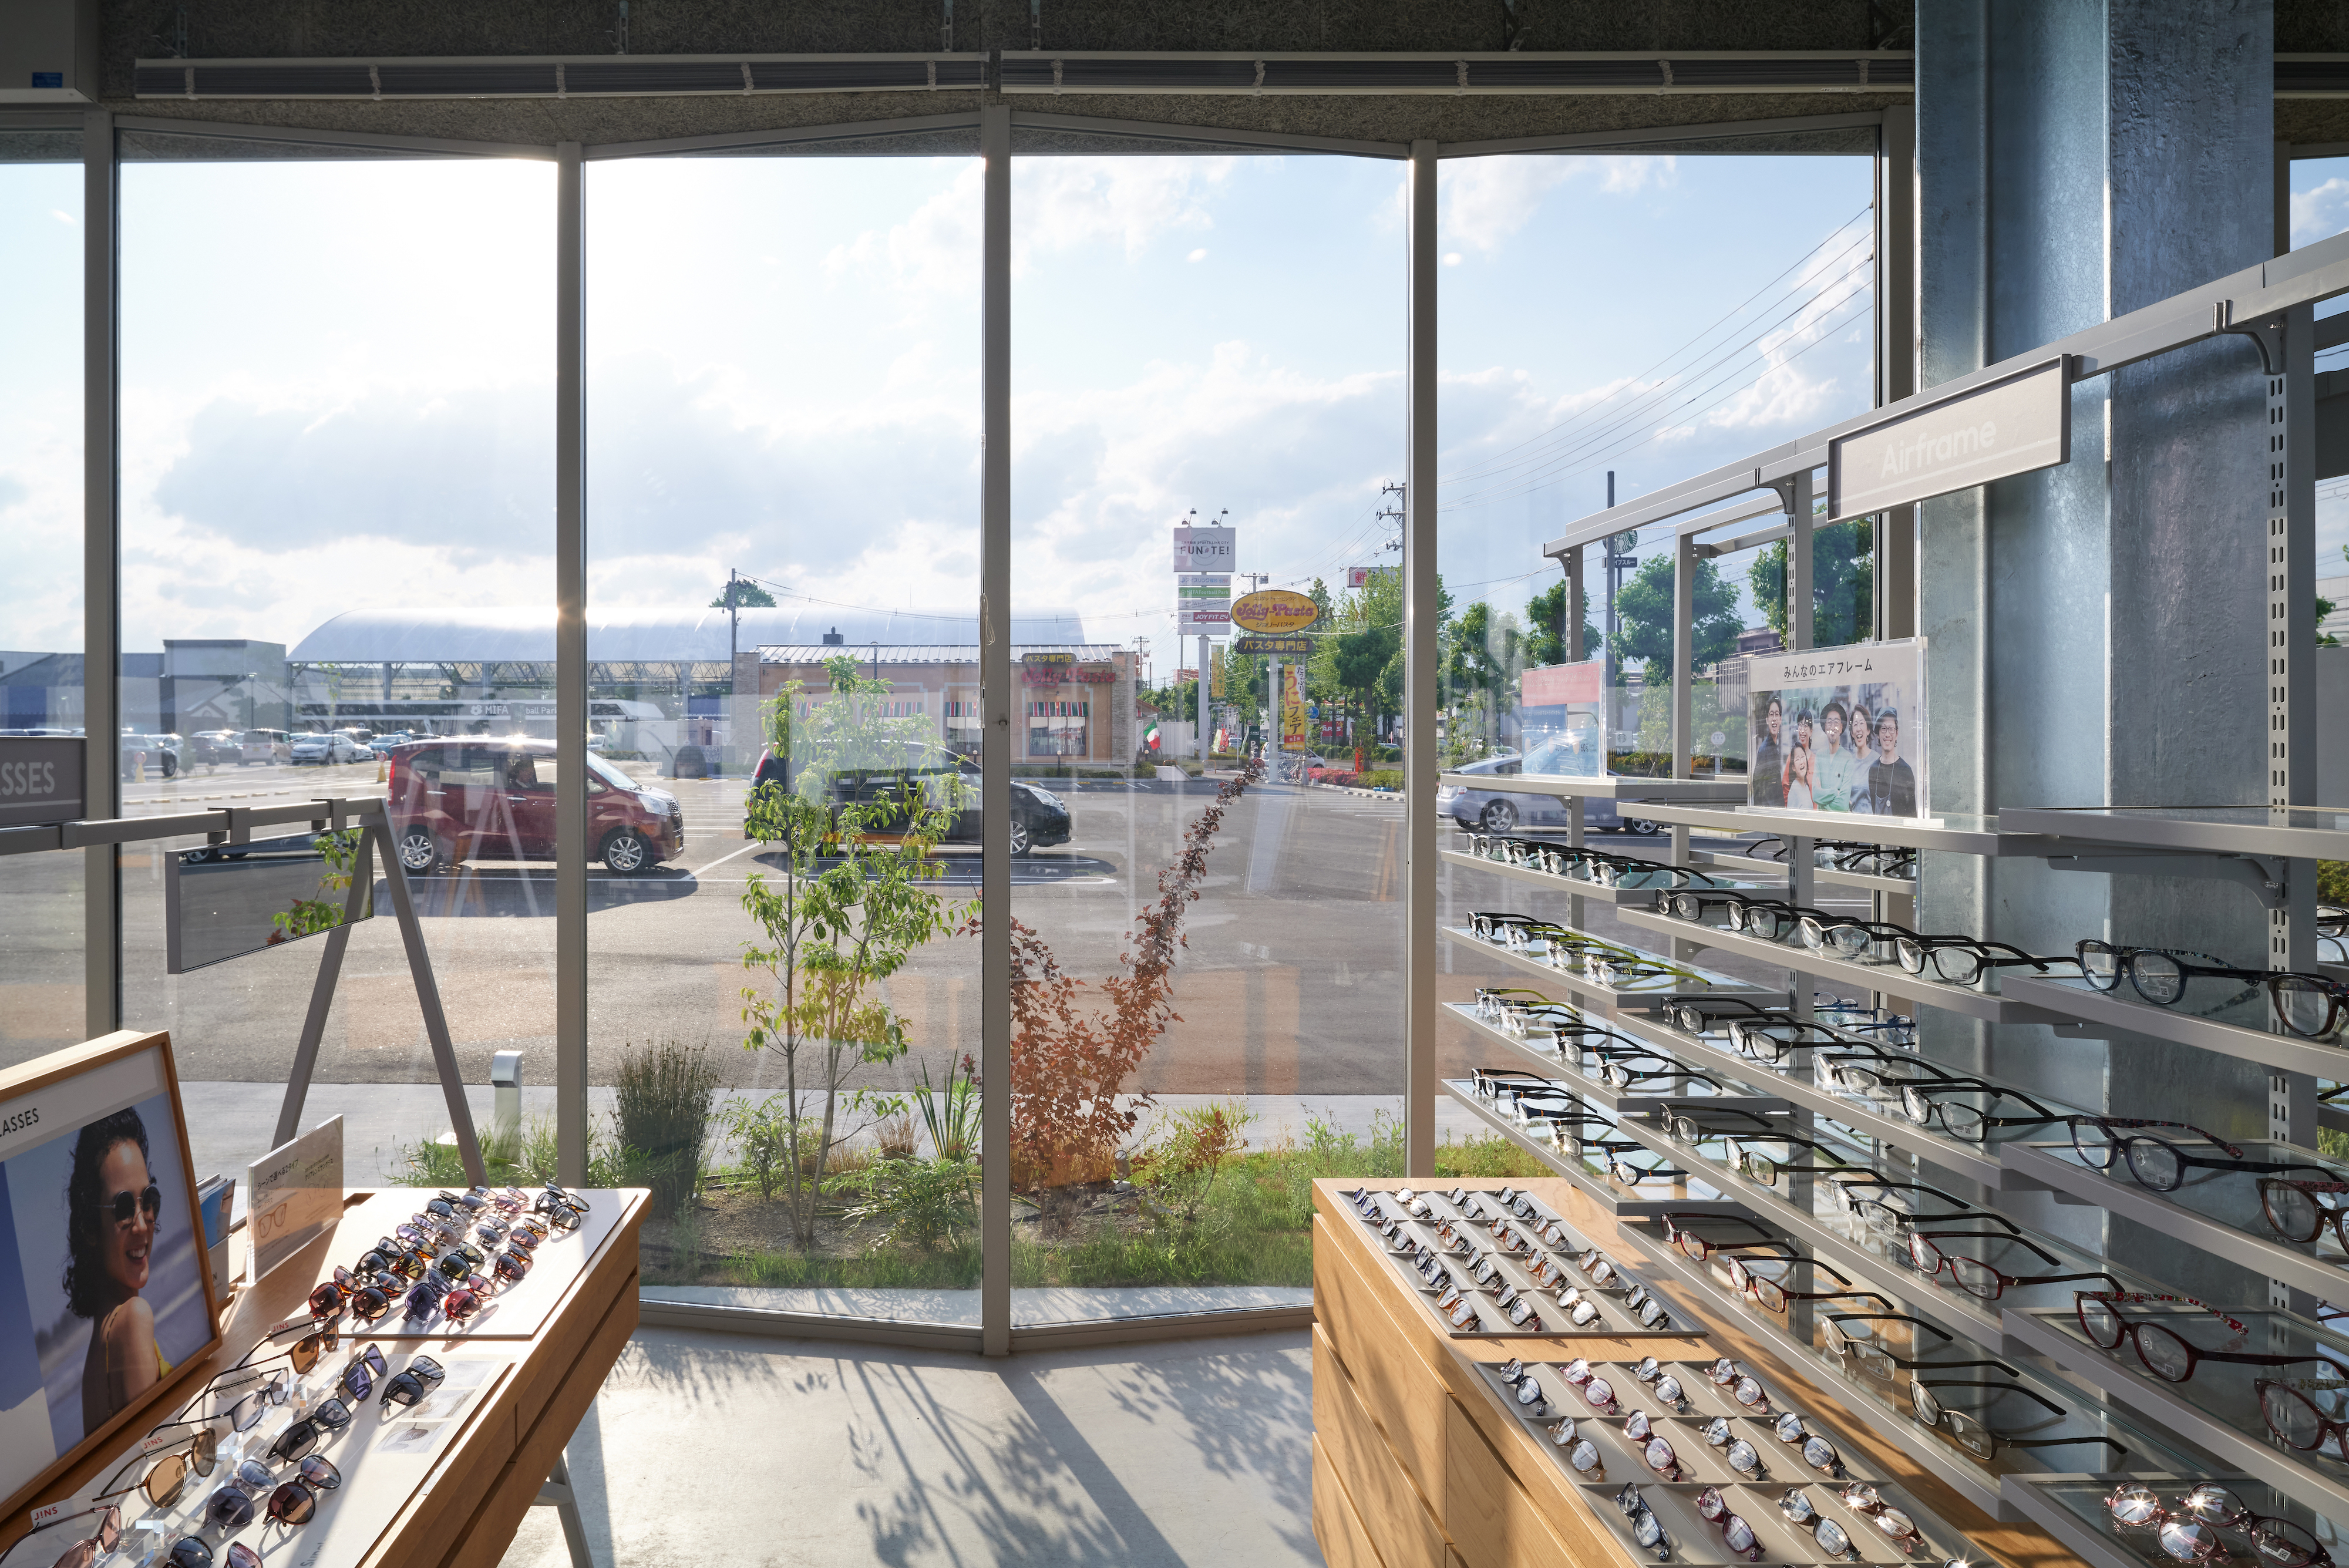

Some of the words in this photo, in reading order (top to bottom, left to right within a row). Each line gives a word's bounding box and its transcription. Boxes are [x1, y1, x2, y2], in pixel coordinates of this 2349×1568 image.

[1880, 420, 1997, 479] Airframe
[1180, 546, 1203, 554] FUN
[1236, 603, 1314, 621] Jolly-Pasta
[1244, 640, 1307, 651] パスタ専門店
[1783, 658, 1873, 679] みんなのエアフレーム
[485, 705, 509, 714] MIFA
[1580, 743, 1589, 752] 60%
[0, 762, 55, 796] SSES
